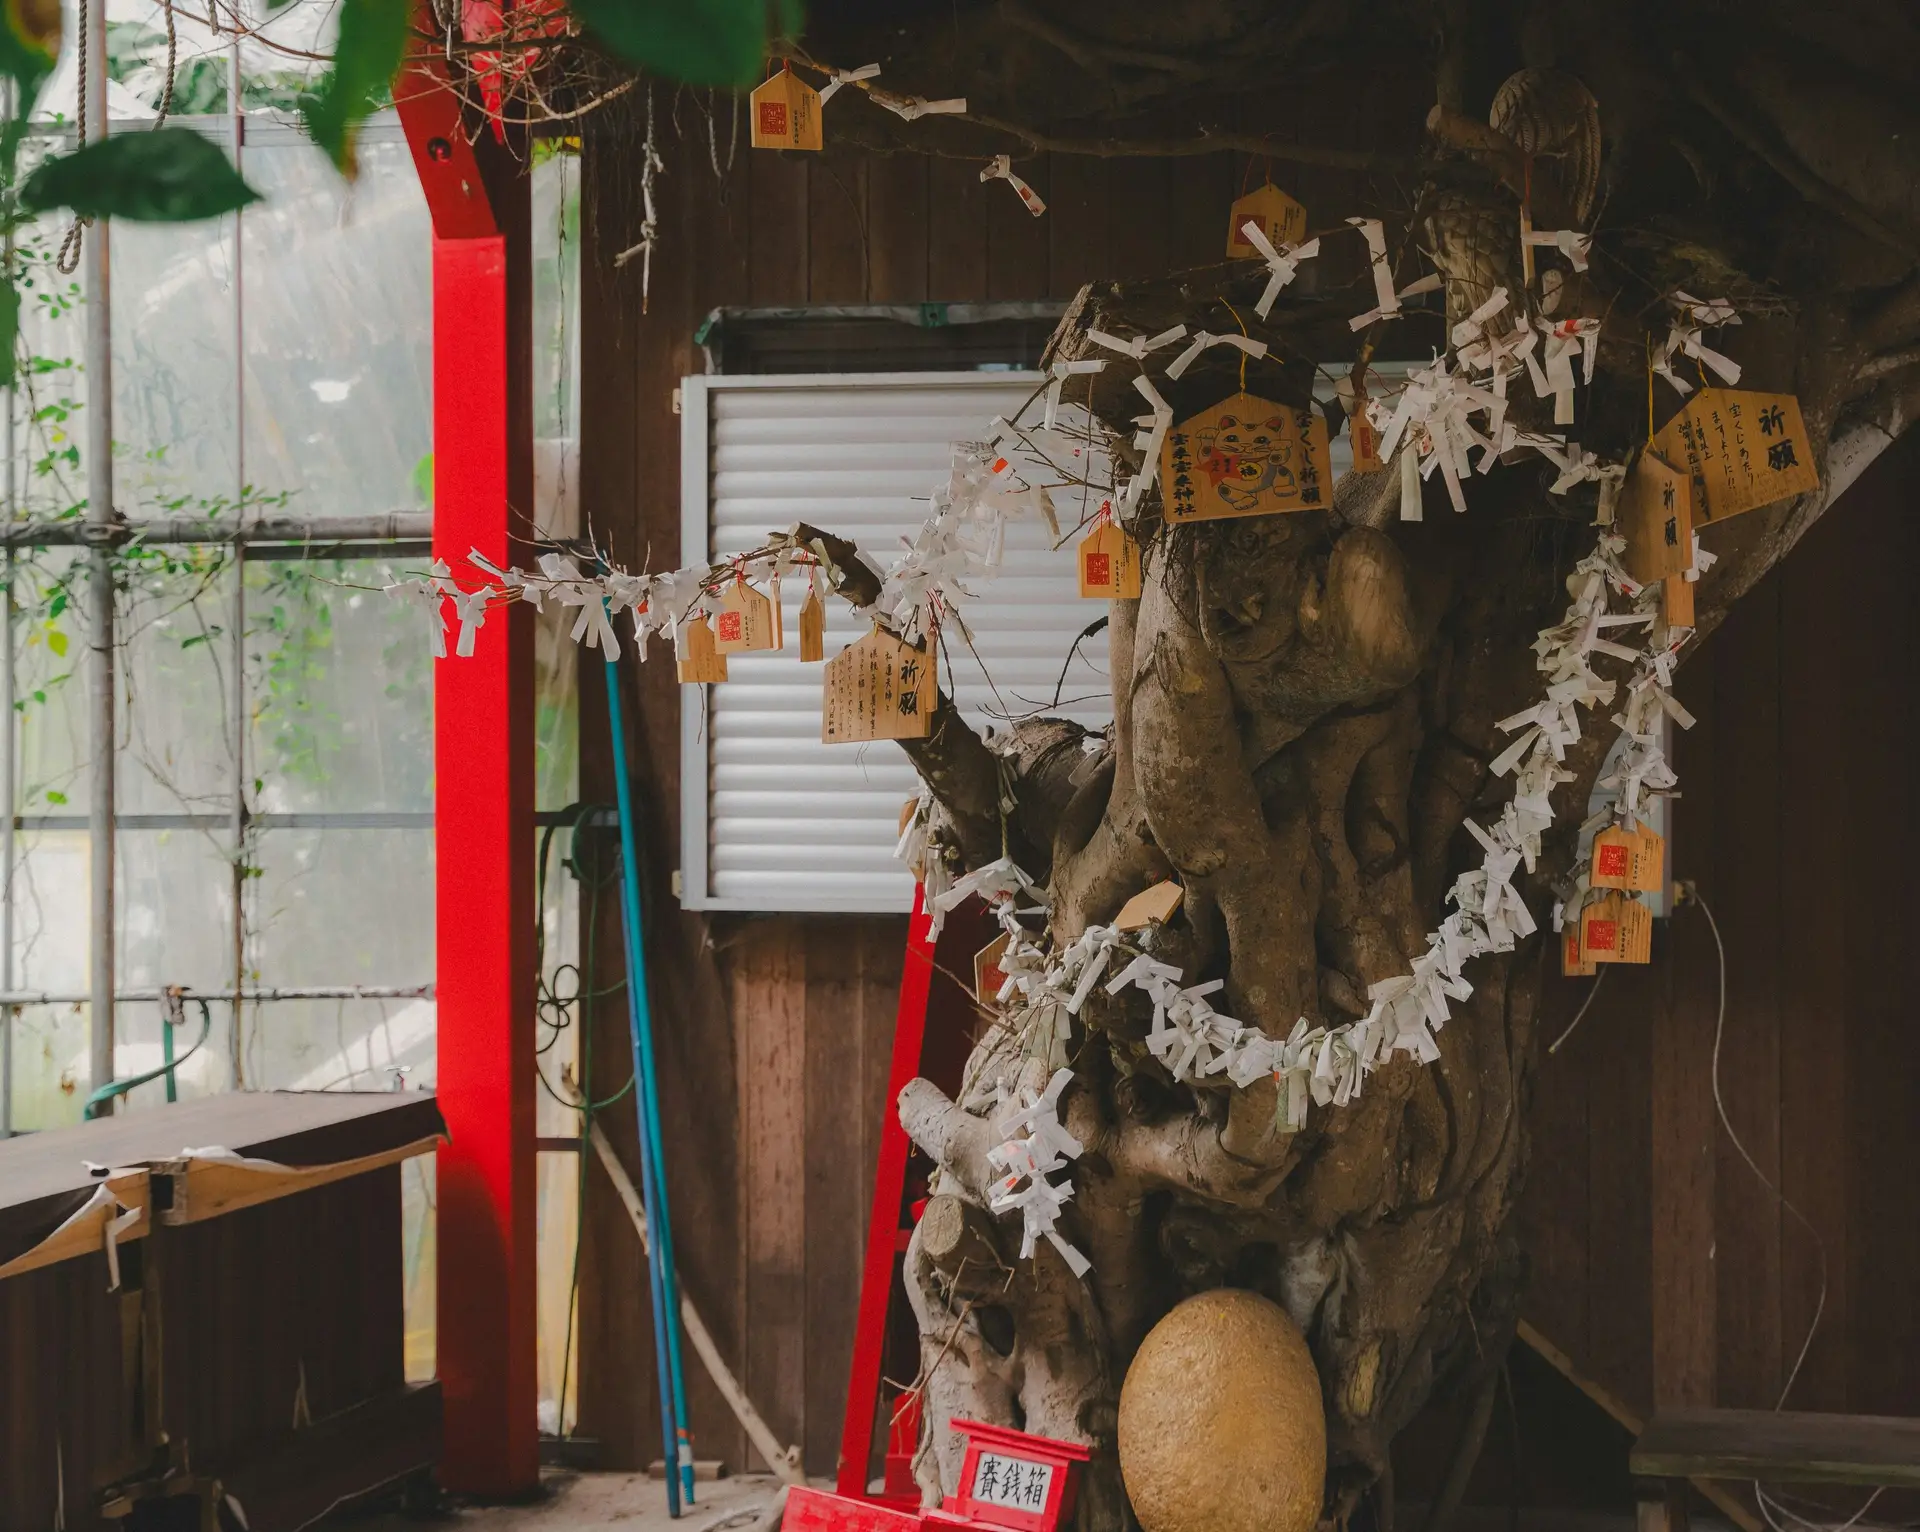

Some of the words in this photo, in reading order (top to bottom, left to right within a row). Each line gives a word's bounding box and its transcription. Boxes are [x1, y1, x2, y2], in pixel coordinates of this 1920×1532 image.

[1728, 402, 1754, 486] 宝くじあたり
[1759, 404, 1799, 472] 祈願
[1663, 479, 1678, 547] 祈願
[899, 659, 919, 716] 祈願
[979, 1456, 1046, 1507] 賽銭箱
